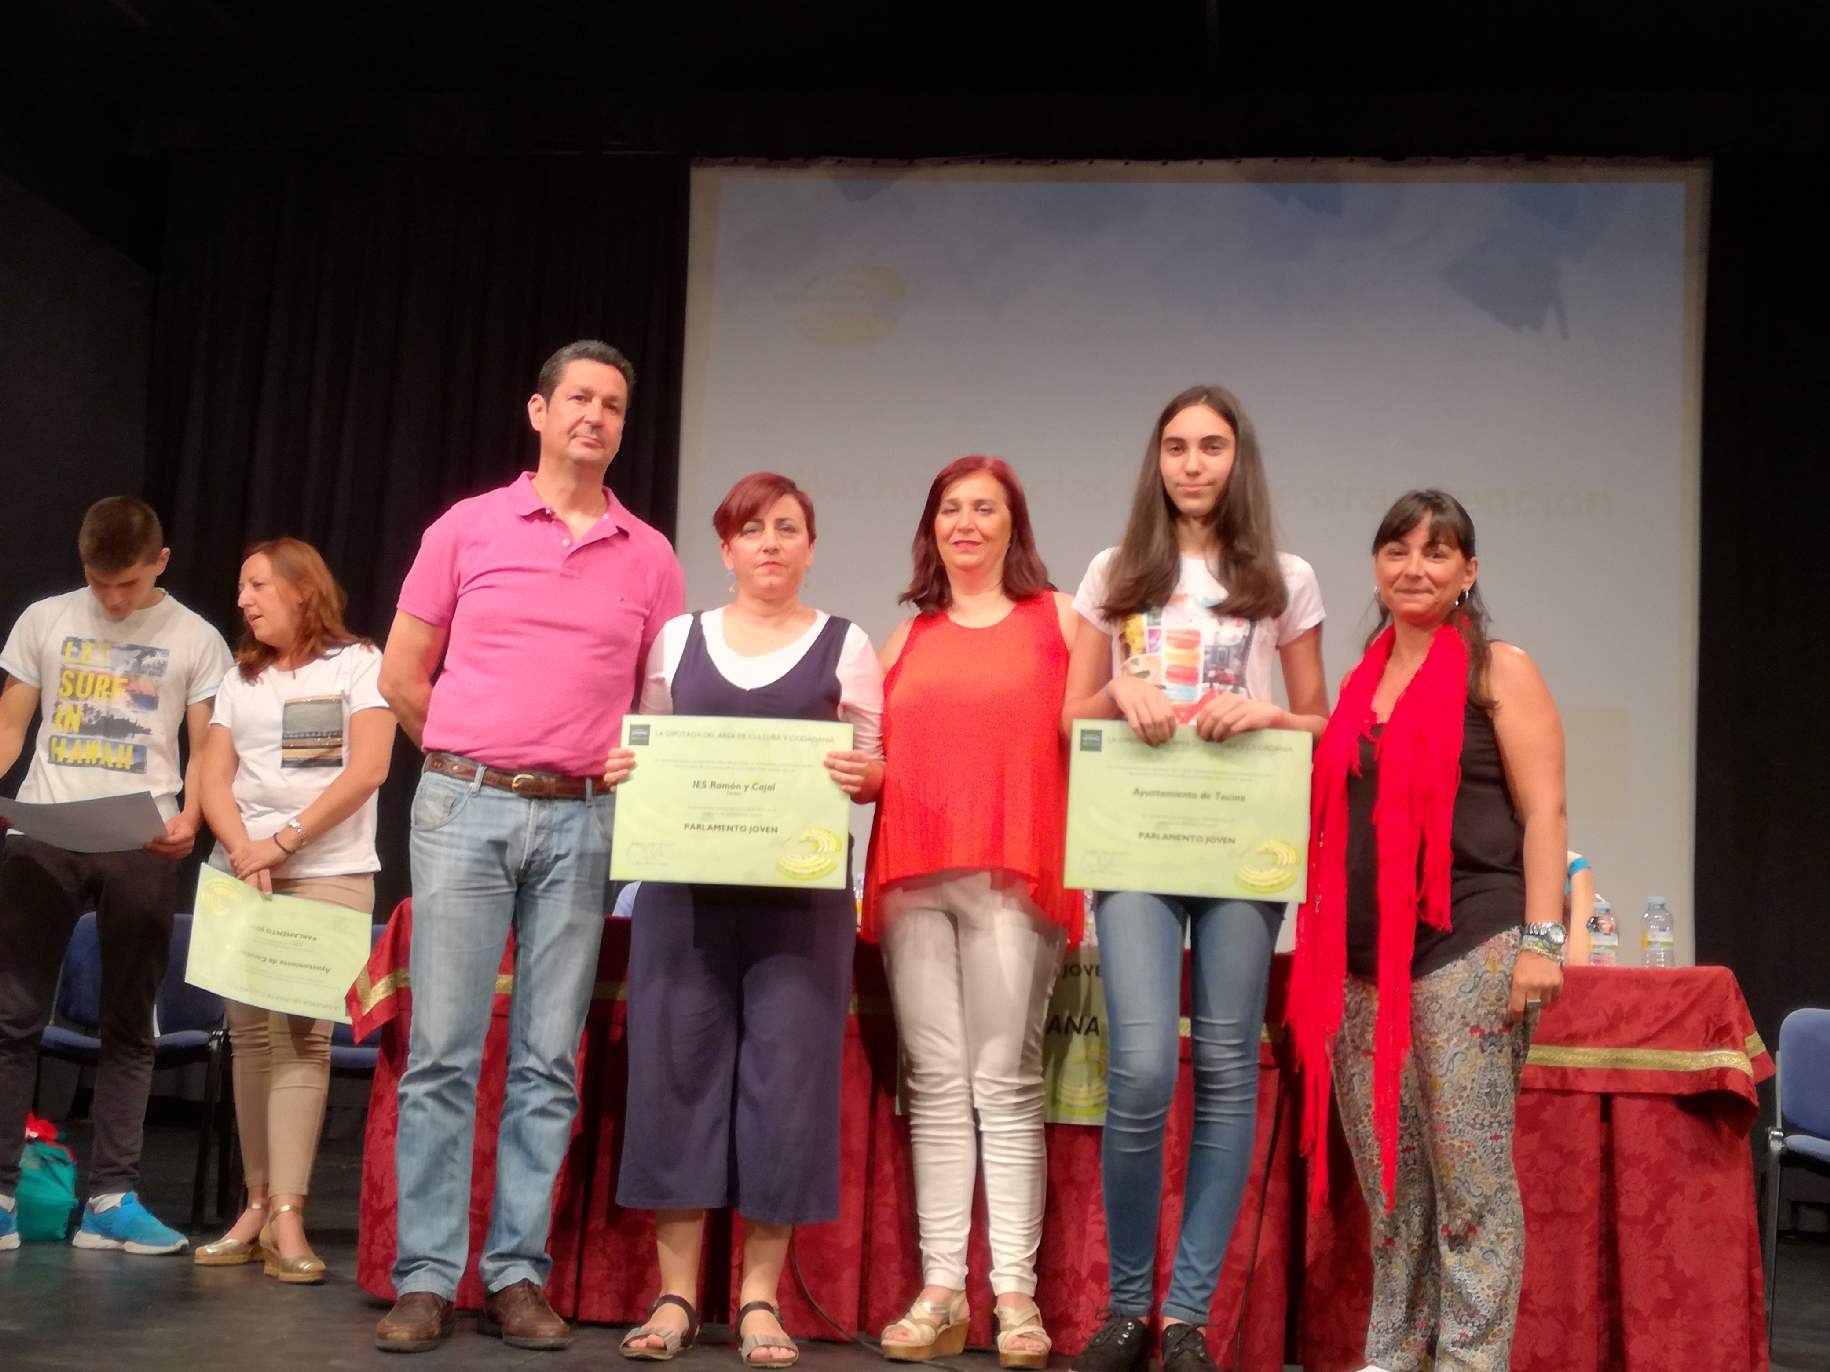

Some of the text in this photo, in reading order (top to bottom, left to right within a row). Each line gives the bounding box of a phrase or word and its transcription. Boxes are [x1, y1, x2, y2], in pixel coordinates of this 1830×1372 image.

[57, 670, 128, 703] SURF
[53, 701, 82, 734] IN
[50, 737, 134, 770] HAWAII
[692, 780, 776, 793] IES Ramón y Cajal
[1200, 791, 1211, 800] de
[683, 823, 779, 835] PARLAMENTO JOVEN
[1138, 831, 1236, 845] PARLAMENTO JOVEN
[1062, 964, 1101, 978] JOVE
[1046, 1014, 1099, 1035] ANA
